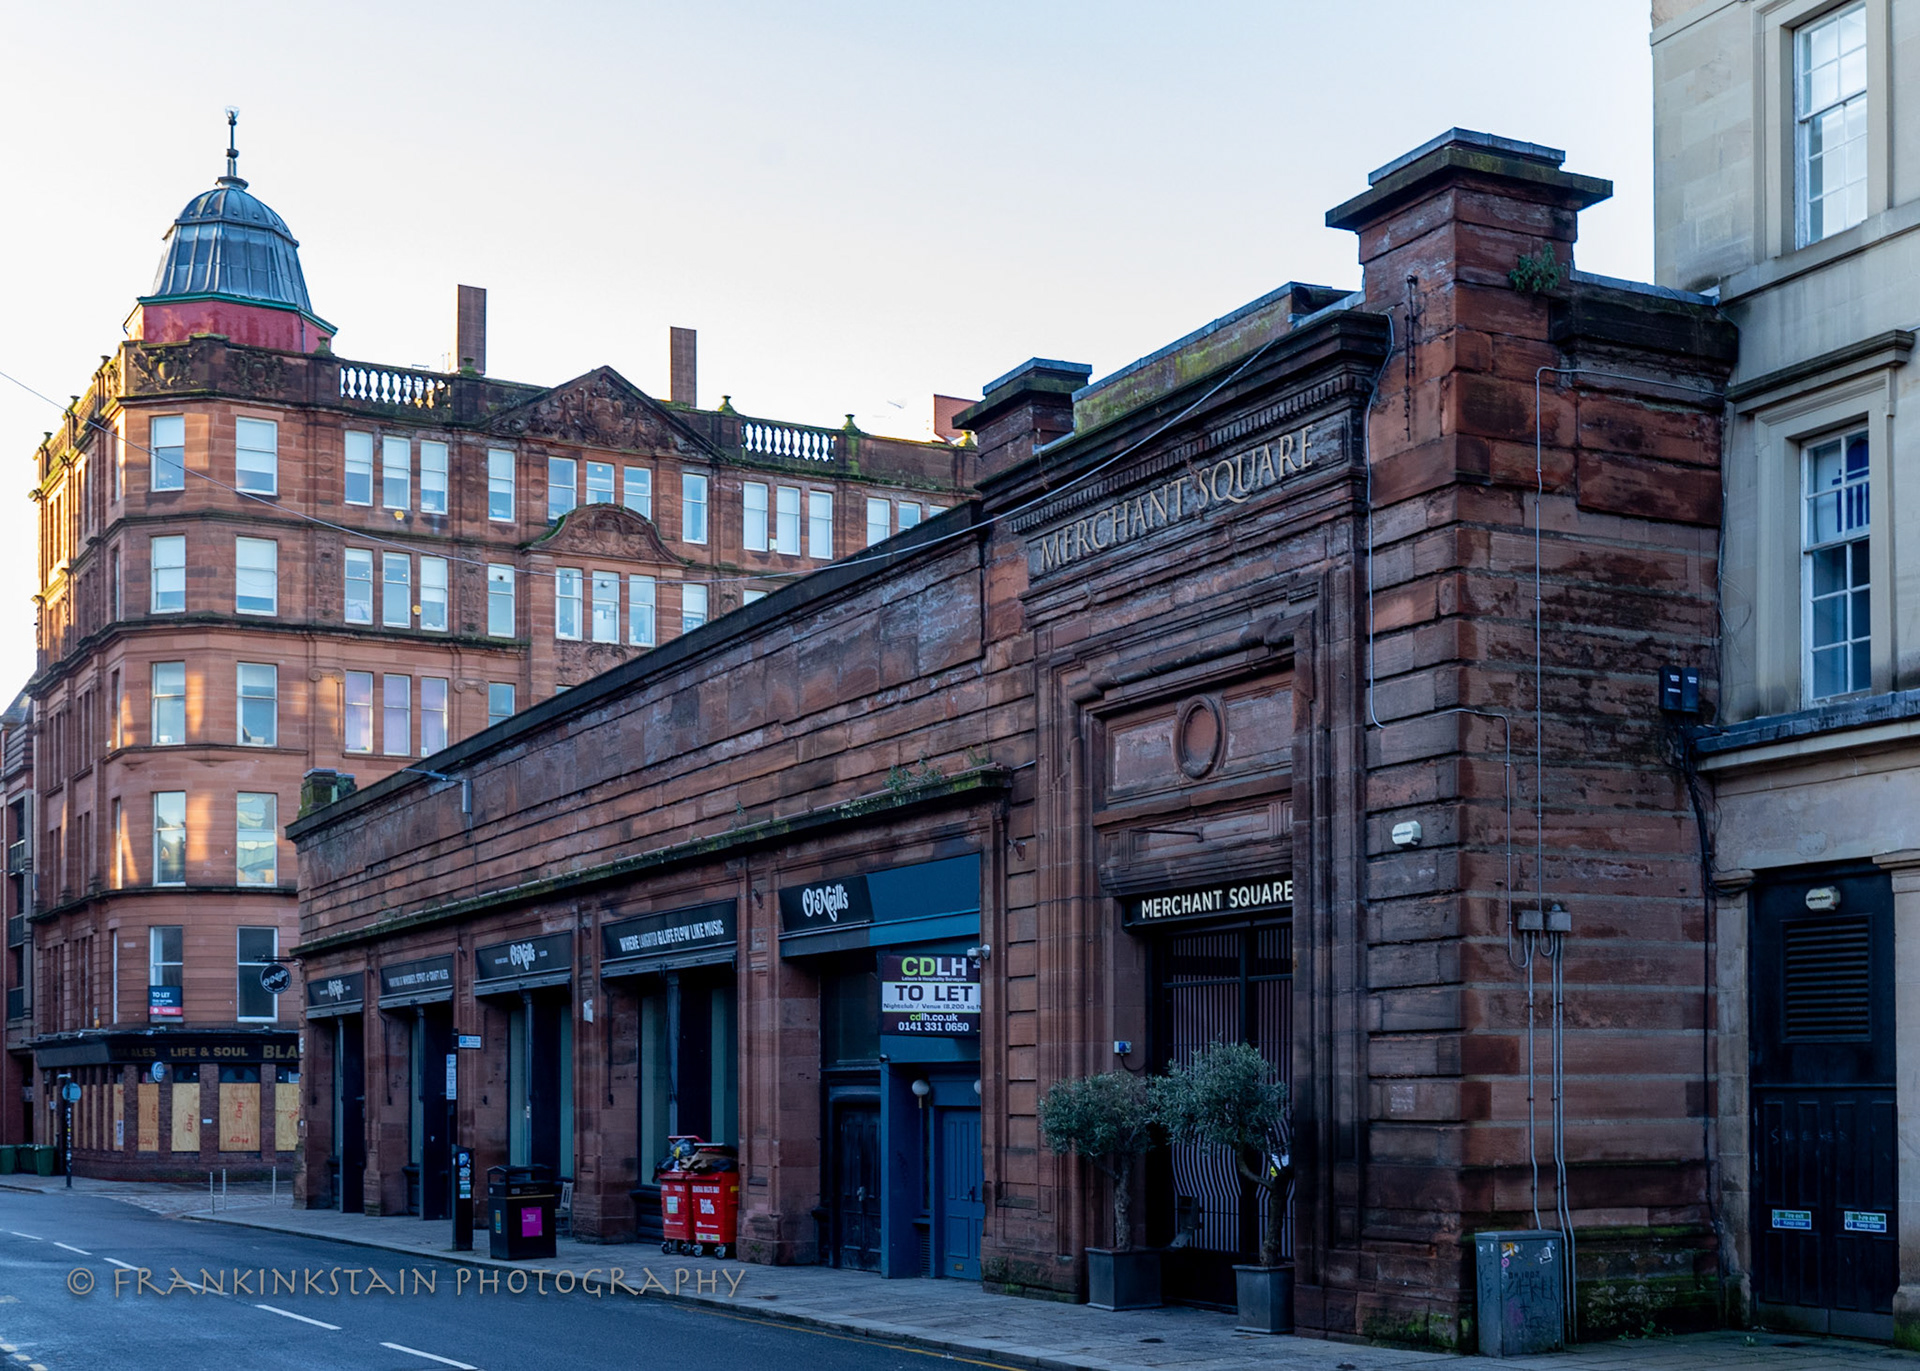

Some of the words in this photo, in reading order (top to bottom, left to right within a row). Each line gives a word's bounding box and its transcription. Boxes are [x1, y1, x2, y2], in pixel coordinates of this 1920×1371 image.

[1040, 475, 1189, 572] MERCHANT
[1197, 424, 1314, 510] SQUARE
[802, 883, 849, 922] O'Neill's
[1141, 890, 1222, 919] MERCHANT
[1229, 880, 1293, 908] SQUARE
[618, 935, 640, 952] WHERE
[663, 928, 675, 944] LIFE
[674, 925, 691, 942] FLOW
[690, 922, 705, 939] LIKE
[704, 919, 724, 936] MUSIC
[902, 956, 967, 976] CDLH
[894, 984, 924, 1001] TO
[934, 985, 973, 1002] LET
[910, 1012, 958, 1021] cdlh.co.uk
[898, 1022, 922, 1031] 0141
[925, 1022, 942, 1031] 331
[945, 1023, 969, 1032] 0650
[170, 1047, 196, 1057] LIFE
[200, 1047, 209, 1057] &
[213, 1047, 248, 1057] SOUL
